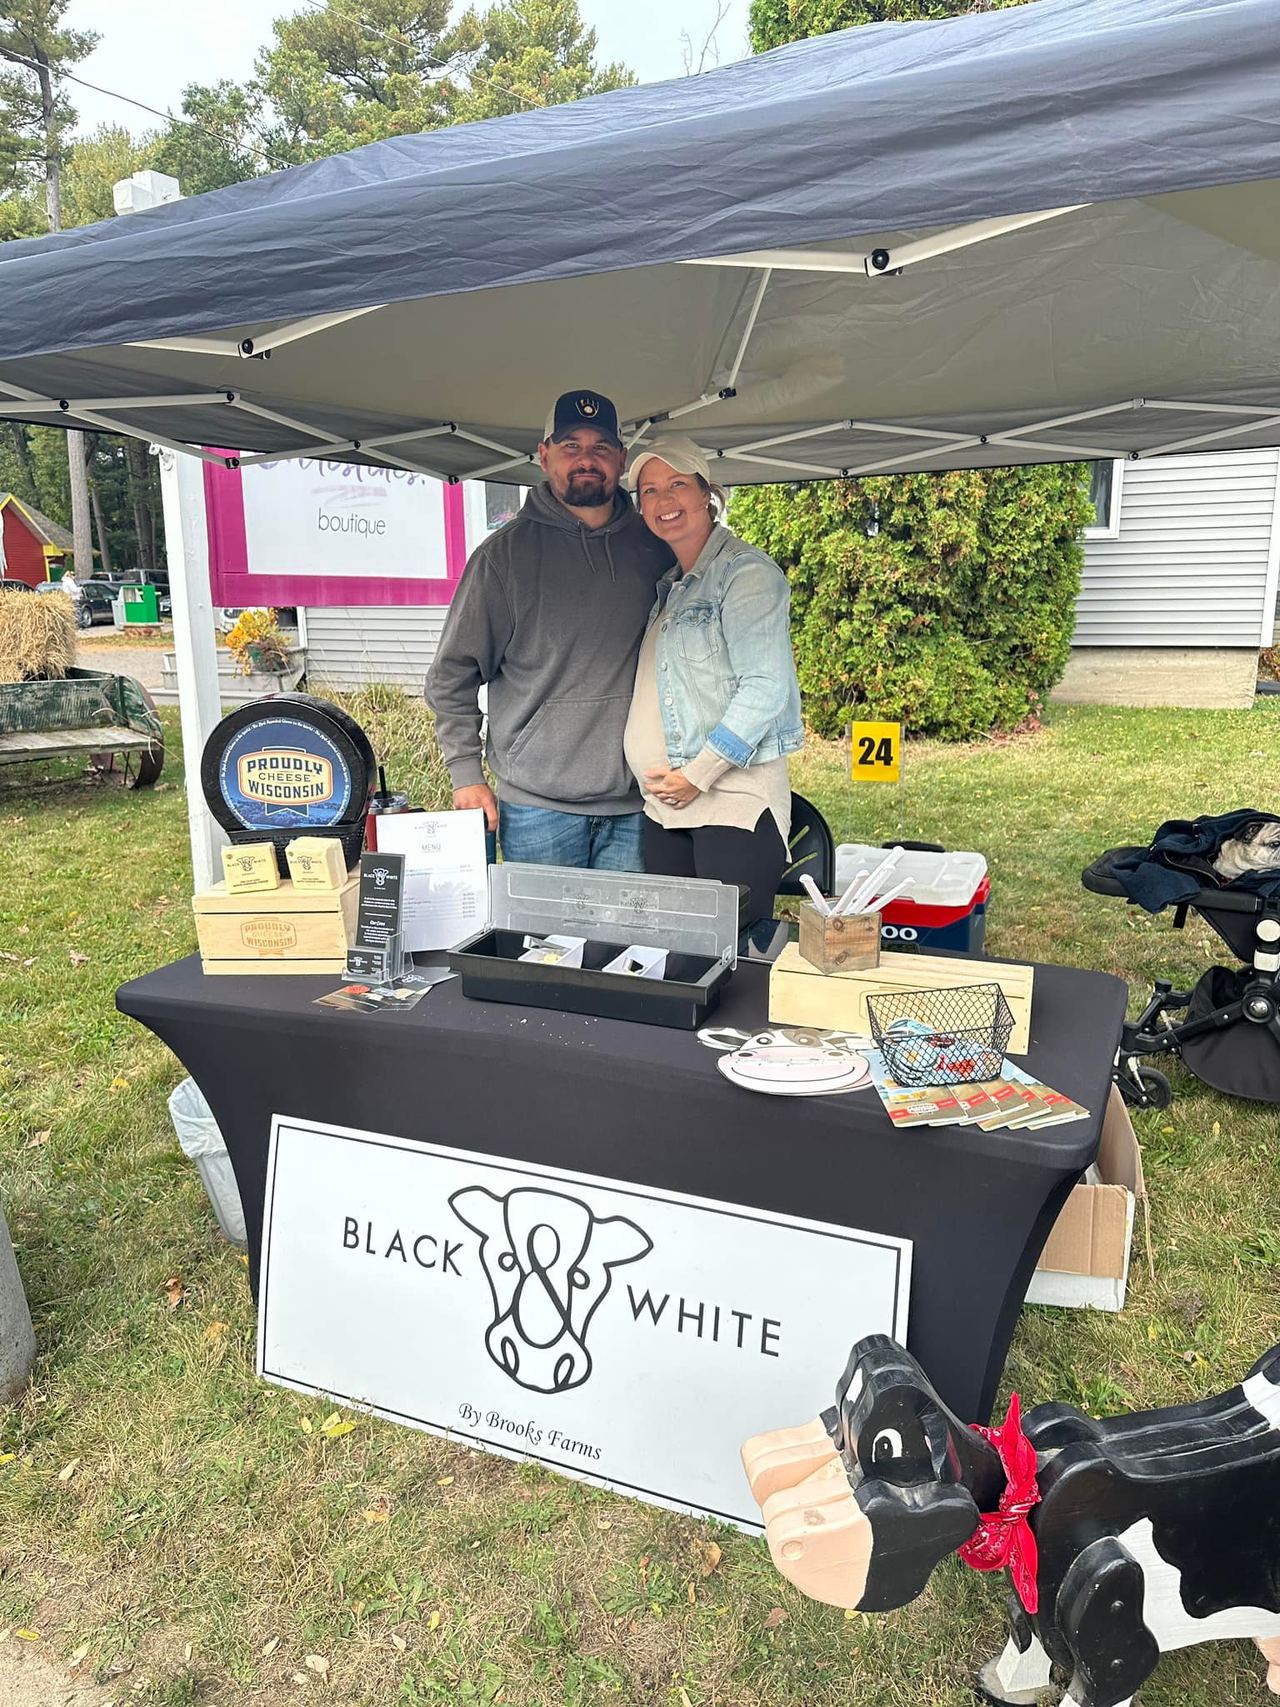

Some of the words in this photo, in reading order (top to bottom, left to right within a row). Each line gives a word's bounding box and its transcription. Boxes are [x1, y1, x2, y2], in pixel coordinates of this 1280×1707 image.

[318, 506, 386, 539] boutique
[858, 736, 894, 766] 24
[247, 757, 323, 775] PROUDLY
[258, 772, 311, 783] CHEESE
[247, 779, 324, 799] WISCONSIN
[421, 843, 441, 851] MENU
[244, 922, 291, 932] PROUDLY
[246, 936, 293, 948] WISCONSIN
[343, 1216, 464, 1277] BLACK
[627, 1284, 782, 1357] WHITE
[458, 1402, 482, 1428] By
[485, 1411, 543, 1446] Brooks
[547, 1430, 602, 1460] Farms
